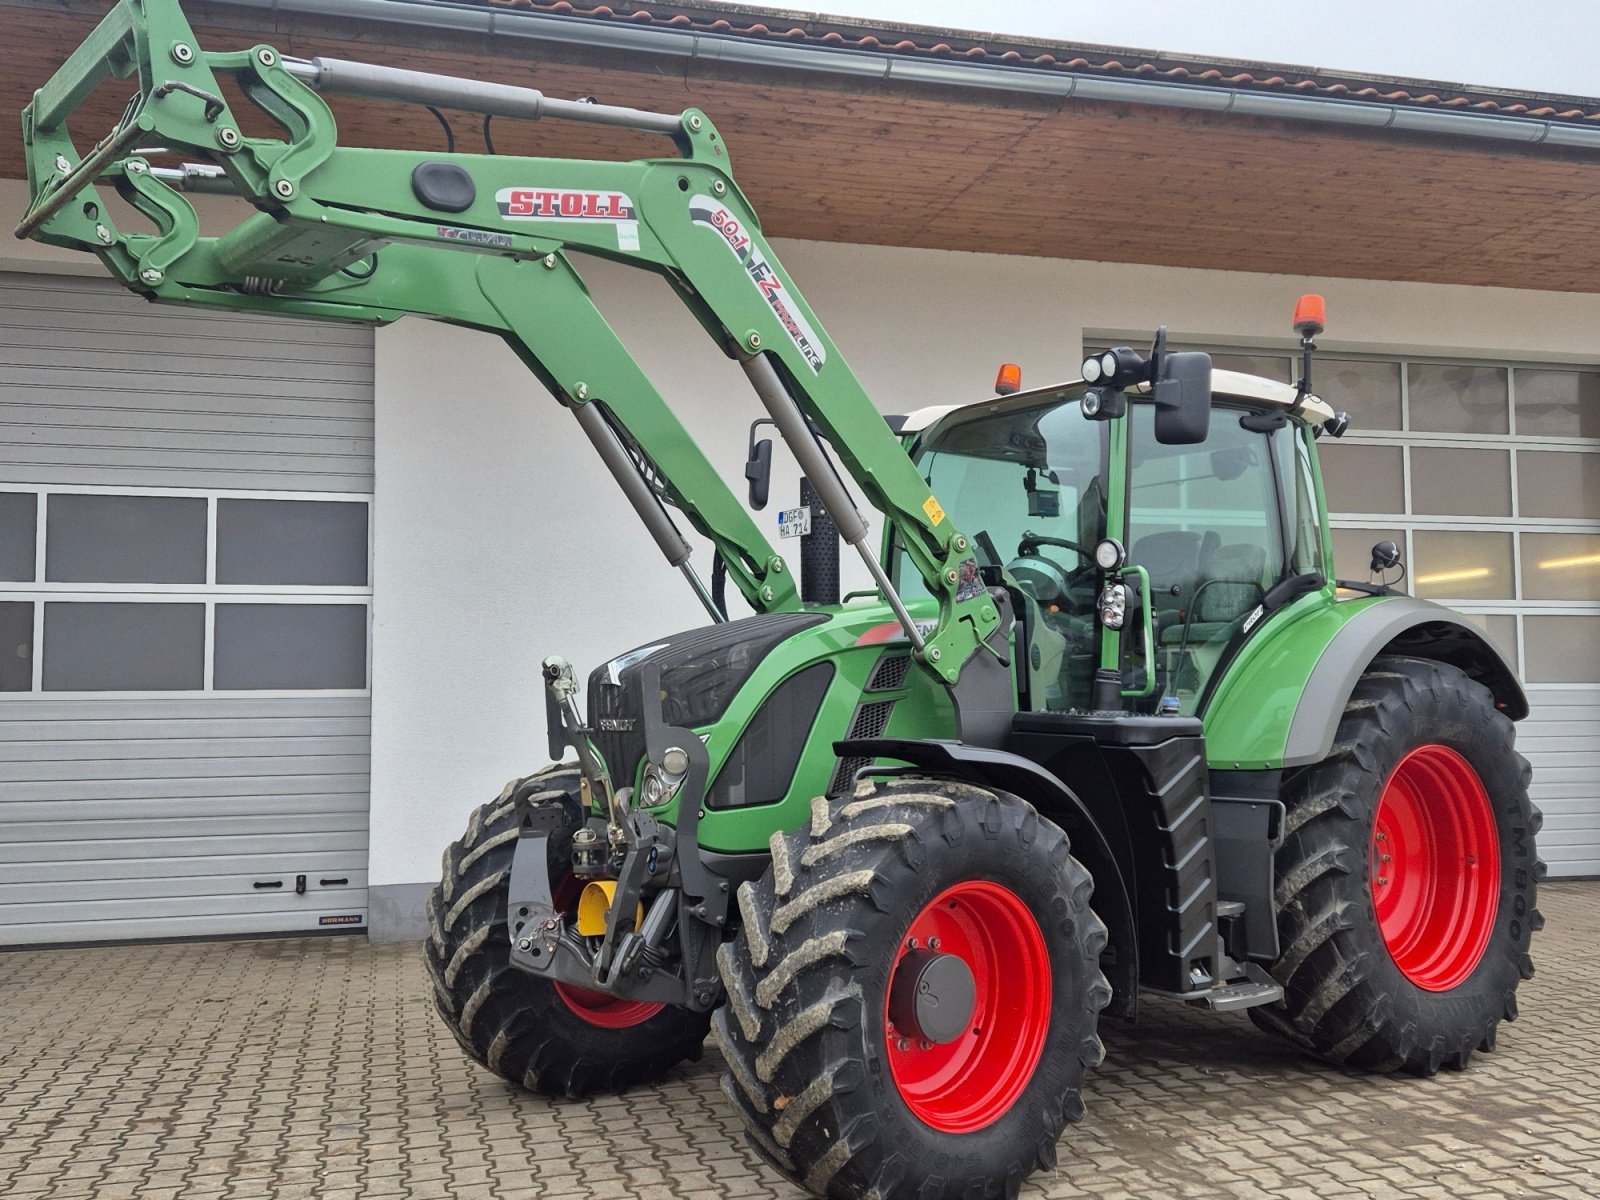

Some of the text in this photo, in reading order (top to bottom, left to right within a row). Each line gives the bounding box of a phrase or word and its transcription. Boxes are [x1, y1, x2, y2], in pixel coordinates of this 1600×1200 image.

[509, 191, 628, 217] STOLL
[711, 209, 749, 250] 50.1
[750, 261, 782, 298] FZ
[780, 525, 790, 536] HA
